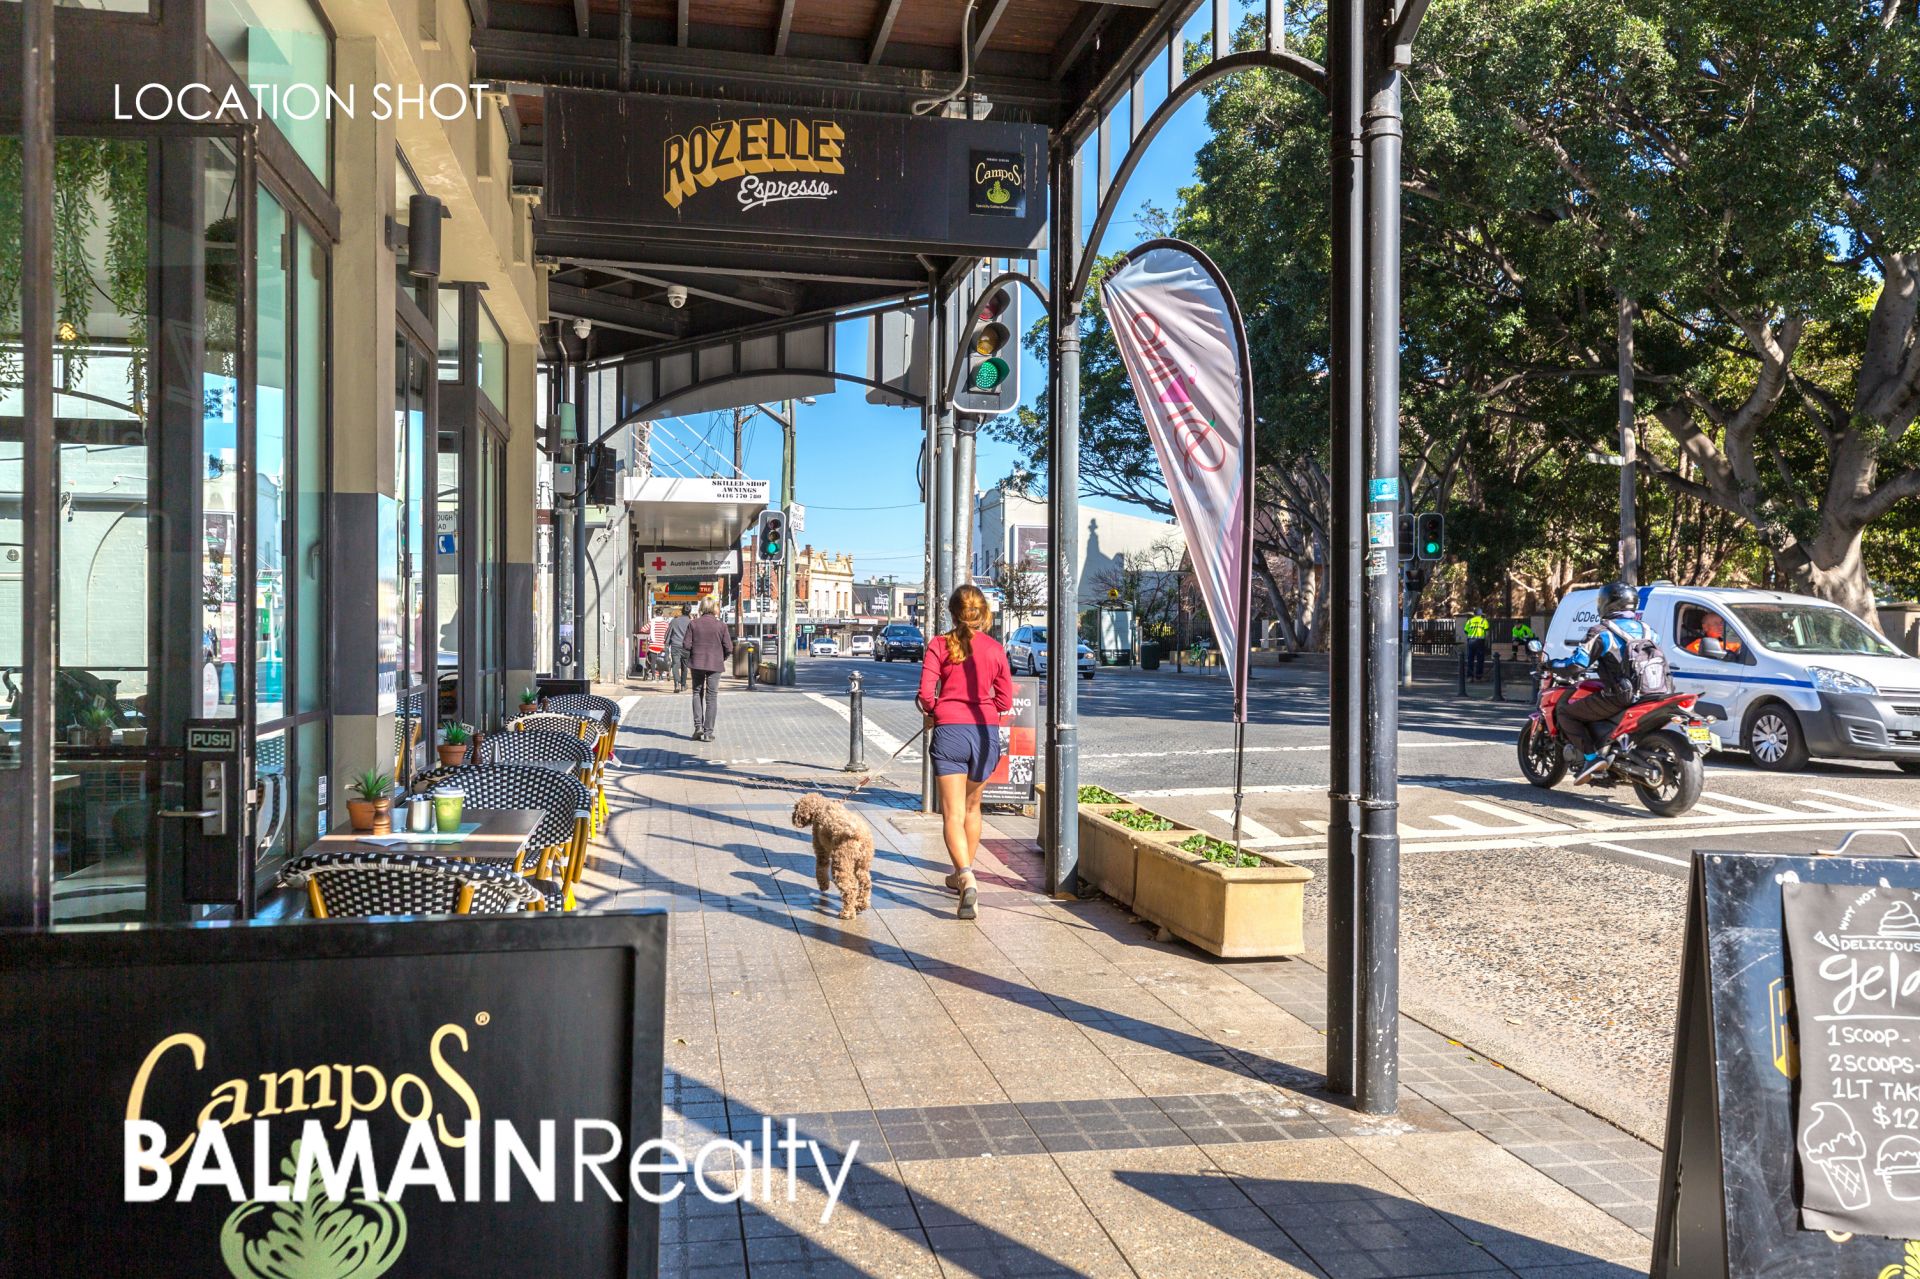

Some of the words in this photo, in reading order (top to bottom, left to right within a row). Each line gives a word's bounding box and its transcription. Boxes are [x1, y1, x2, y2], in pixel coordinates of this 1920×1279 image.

[663, 118, 846, 209] ROZELLE
[193, 733, 231, 747] PUSH
[1838, 905, 1856, 931] WHY
[1855, 888, 1878, 907] NOT
